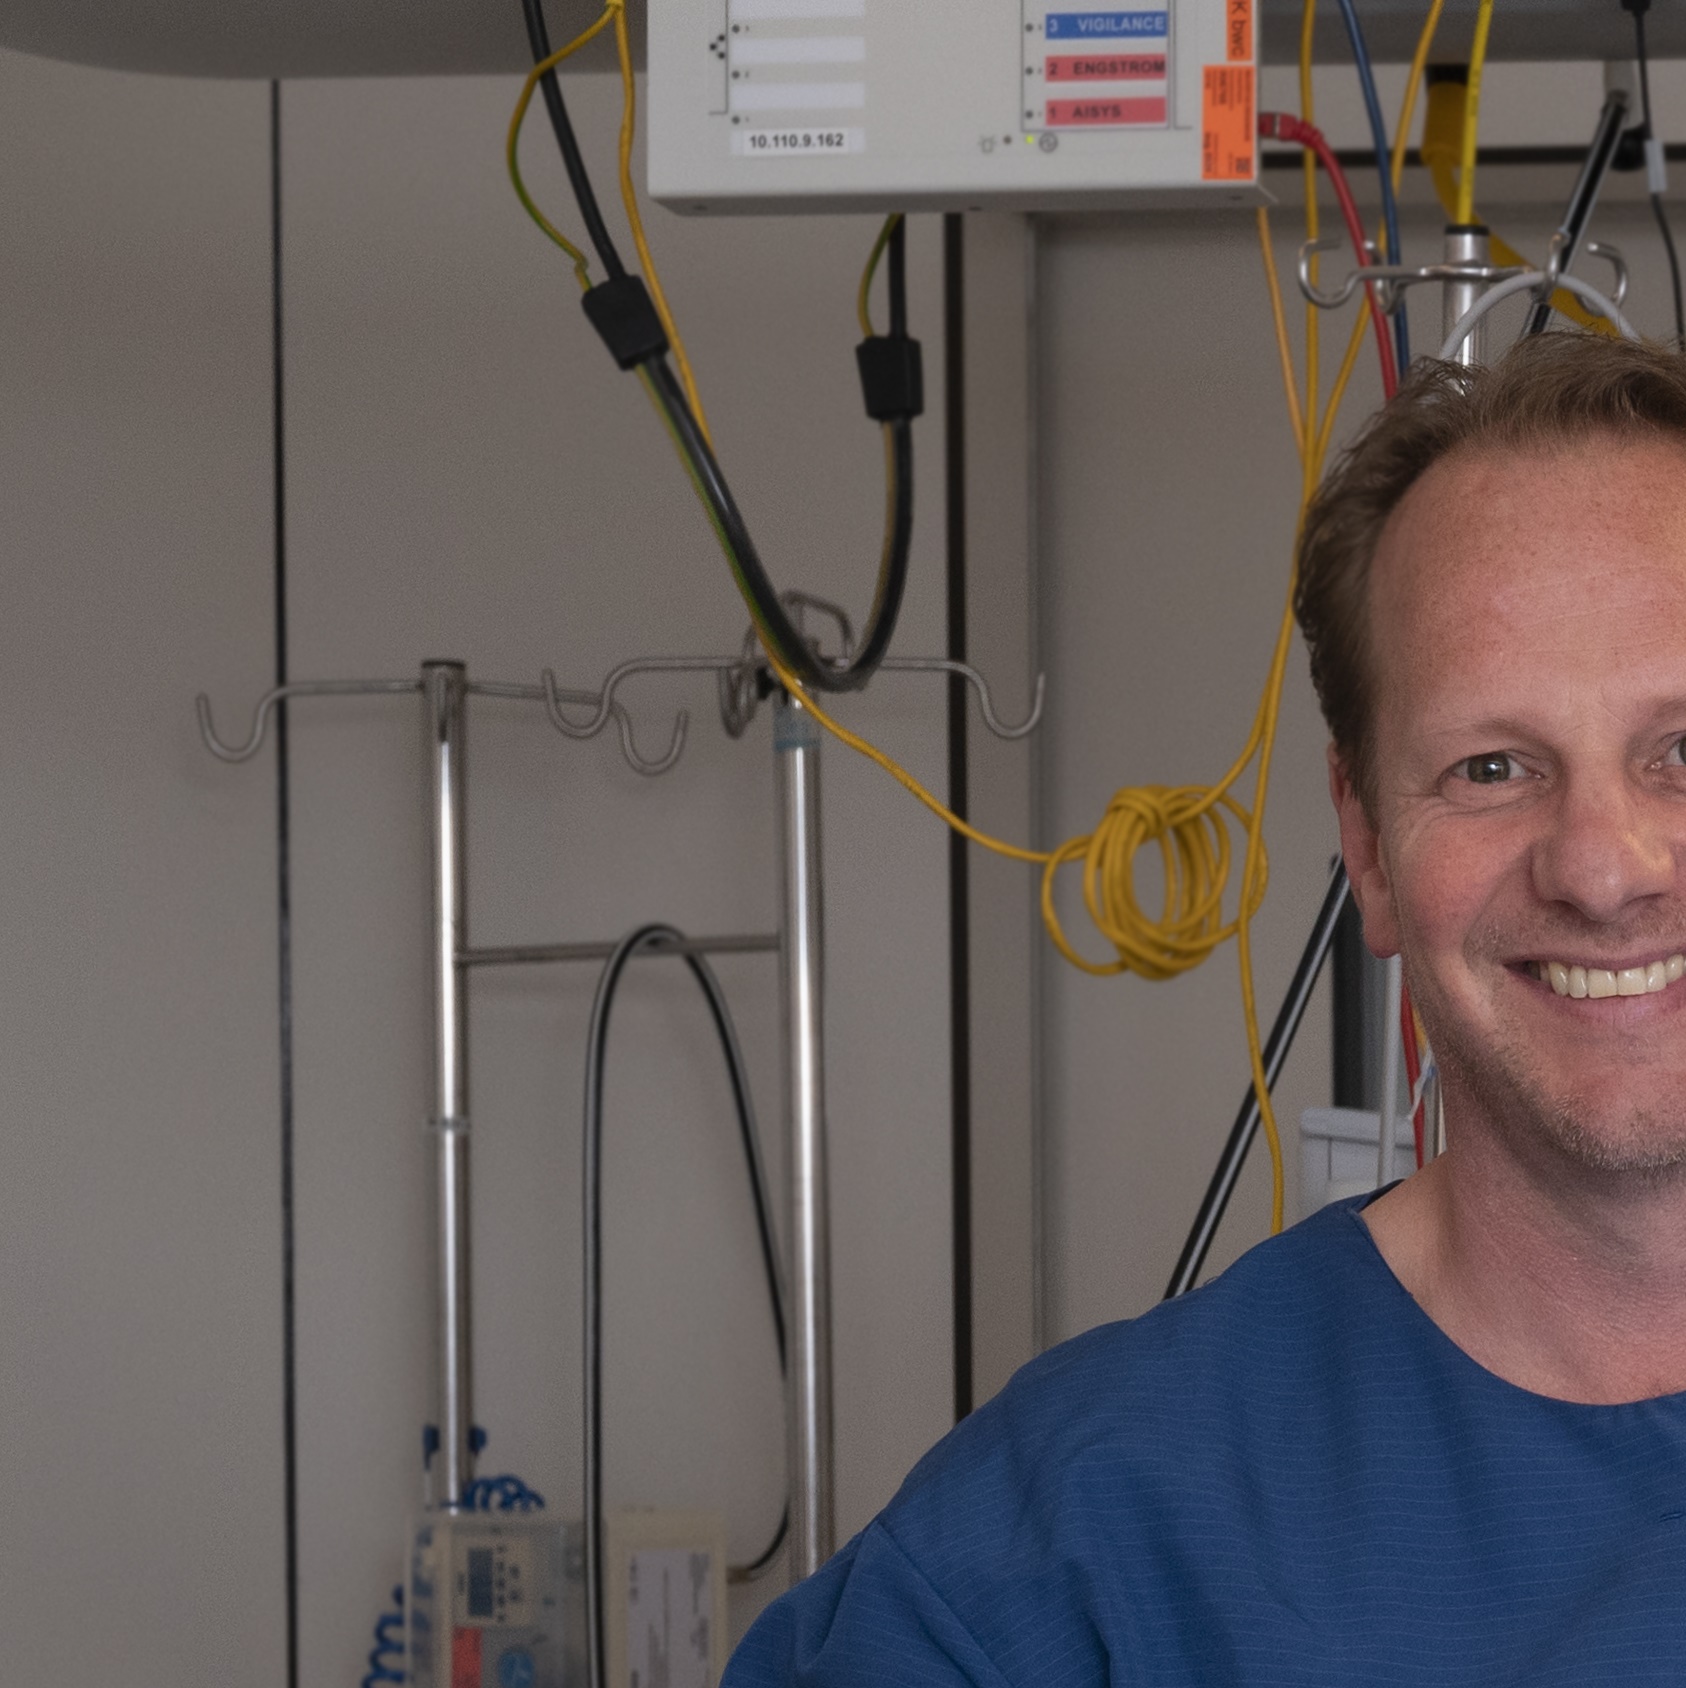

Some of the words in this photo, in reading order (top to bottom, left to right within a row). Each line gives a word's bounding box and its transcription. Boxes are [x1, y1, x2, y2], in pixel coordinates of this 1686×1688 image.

[1049, 17, 1059, 32] 3
[1077, 16, 1164, 32] VIGILANCE
[1049, 62, 1058, 75] 2
[1073, 60, 1166, 76] ENGSTROM
[1072, 105, 1122, 118] AISYS
[750, 133, 844, 149] 10.110.9.162
